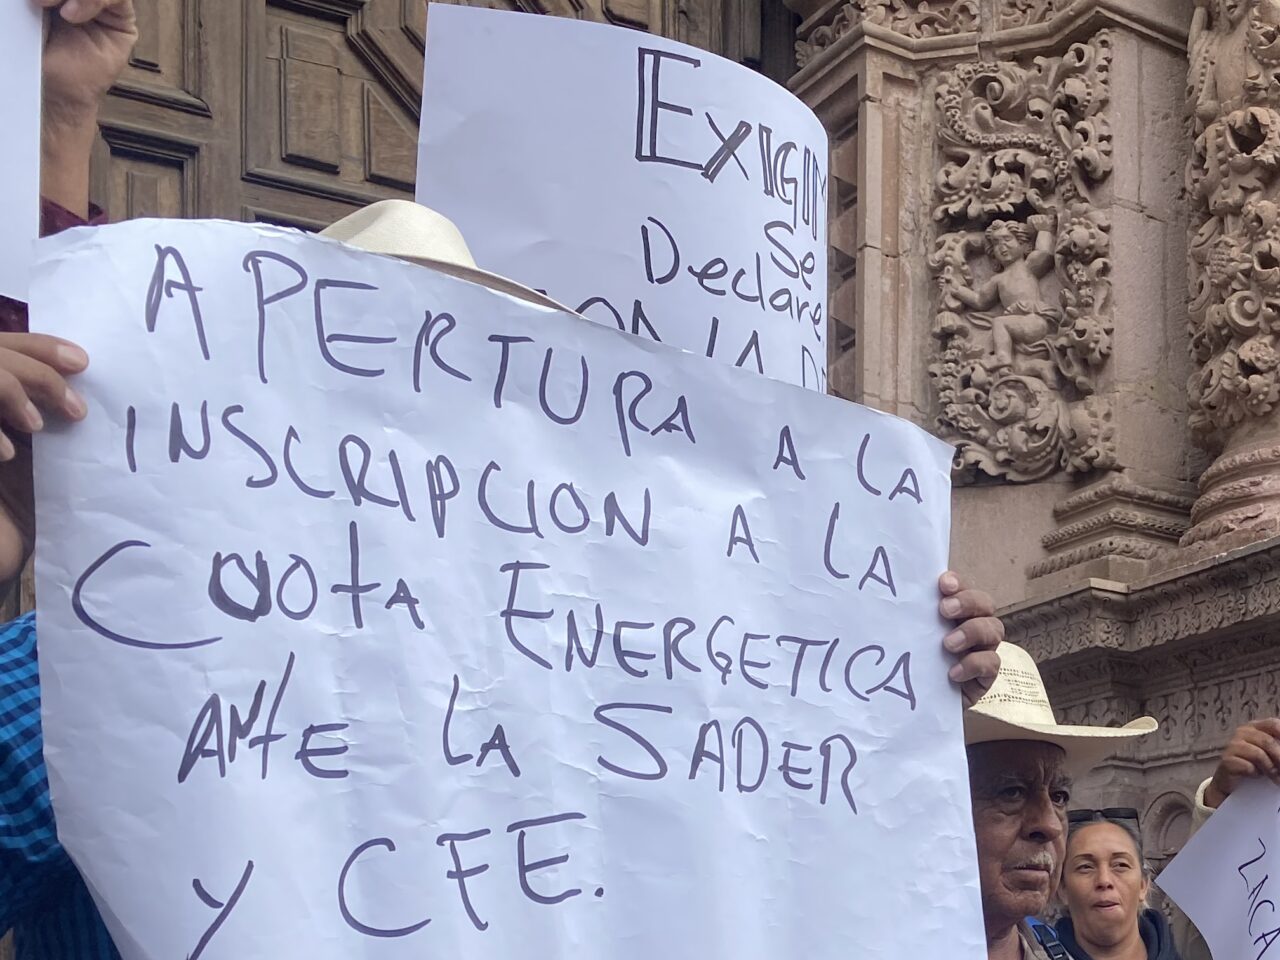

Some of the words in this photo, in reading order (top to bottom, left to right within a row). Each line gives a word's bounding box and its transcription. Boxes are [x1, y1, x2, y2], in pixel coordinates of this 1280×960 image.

[641, 216, 822, 342] Declare
[763, 220, 816, 291] Se
[144, 243, 697, 460] APERTURA
[772, 425, 806, 481] A
[857, 433, 923, 505] LA
[126, 403, 652, 547] INSCRIPCION
[726, 504, 760, 564] A
[823, 502, 897, 598] LA
[499, 560, 917, 712] ENERGETICA
[442, 673, 522, 778] LA
[594, 702, 858, 816] SADER
[337, 812, 605, 938] CFE.
